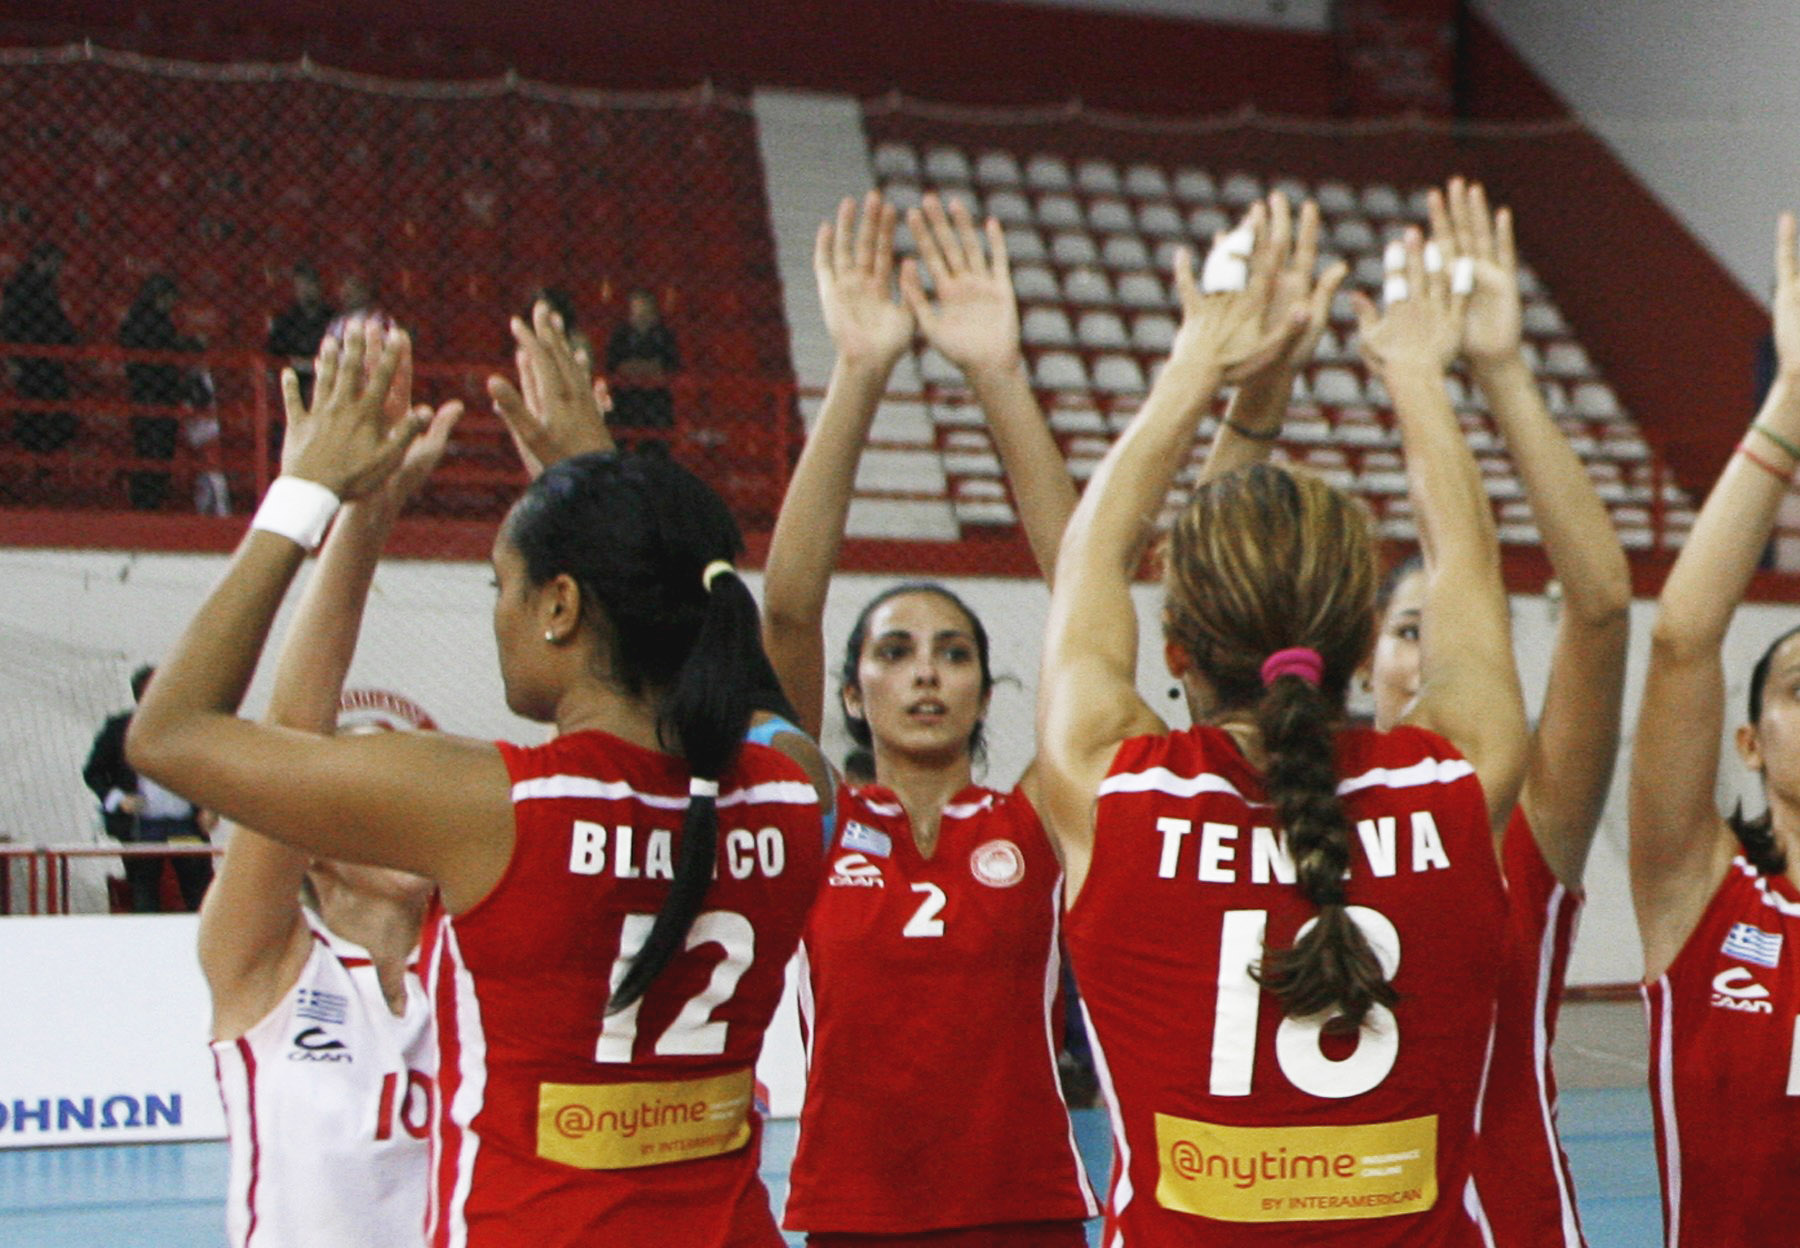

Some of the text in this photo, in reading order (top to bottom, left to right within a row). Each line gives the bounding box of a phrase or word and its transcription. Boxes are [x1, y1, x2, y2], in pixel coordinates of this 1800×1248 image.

[569, 820, 784, 880] BLACO
[1156, 811, 1450, 884] TENVA
[903, 882, 946, 937] 2
[595, 911, 755, 1063] 12
[1209, 905, 1400, 1098] 18
[0, 1093, 182, 1132] ΗΝΩΝ
[555, 1100, 708, 1139] @nytime
[1171, 1140, 1355, 1189] @nytime
